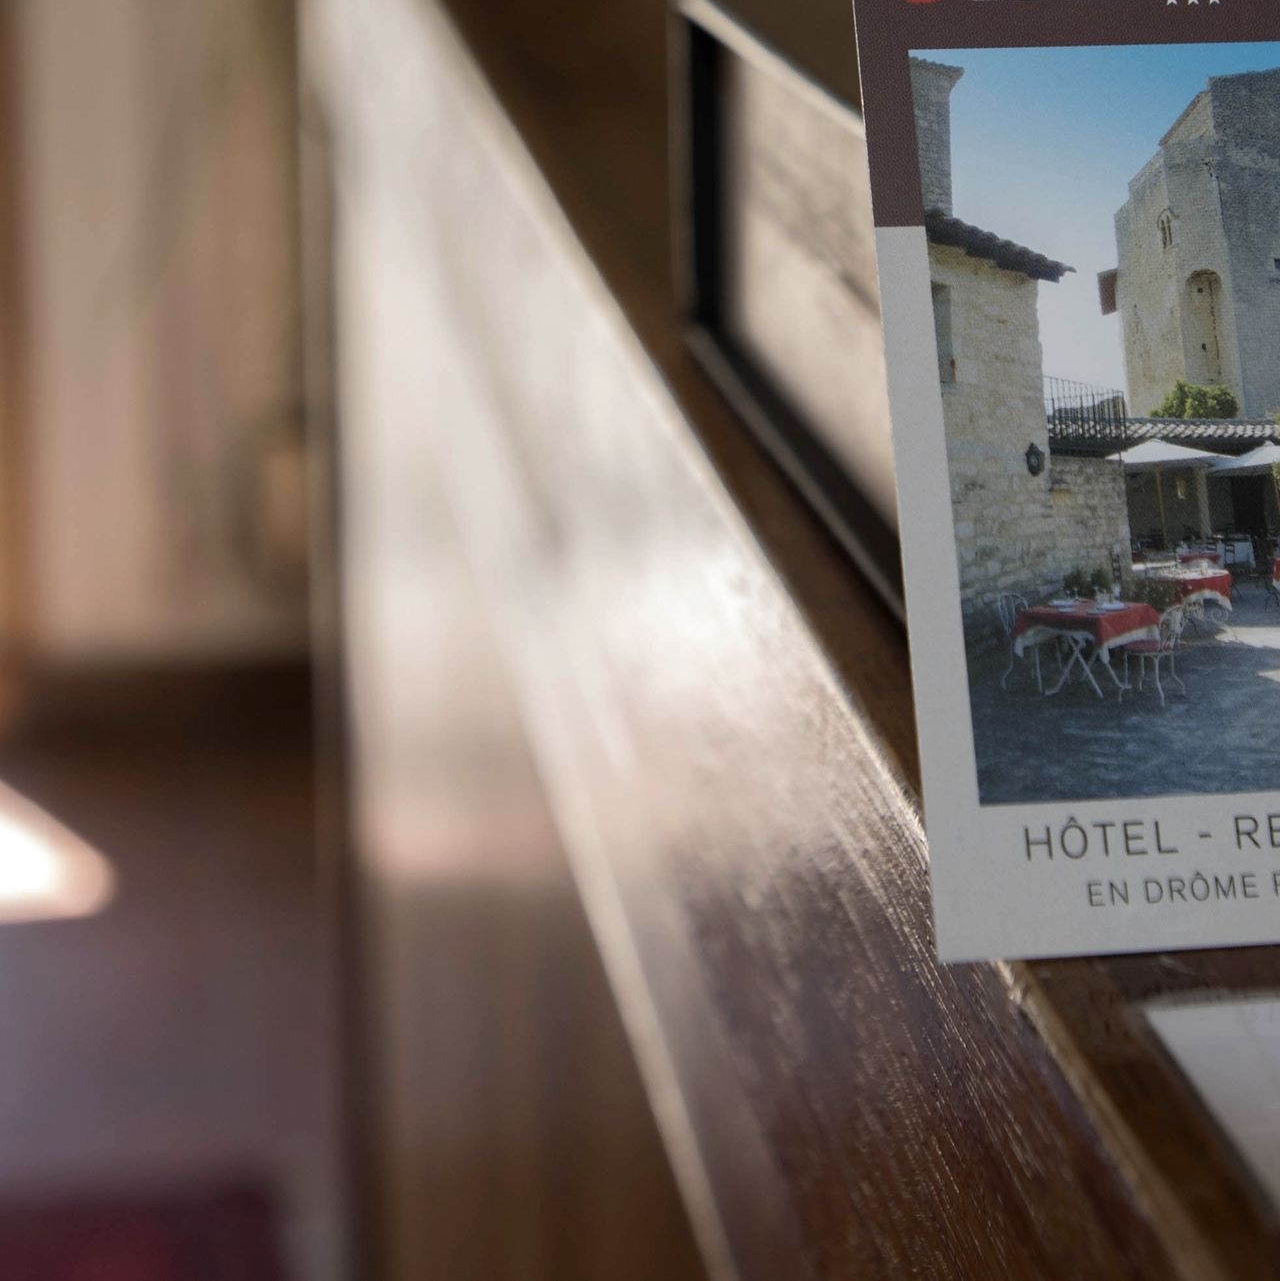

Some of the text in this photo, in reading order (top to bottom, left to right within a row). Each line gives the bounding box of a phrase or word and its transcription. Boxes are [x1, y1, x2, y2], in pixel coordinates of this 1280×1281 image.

[1023, 816, 1178, 861] HÔTEL
[1087, 878, 1129, 908] EN
[1145, 865, 1260, 905] DRÔME
